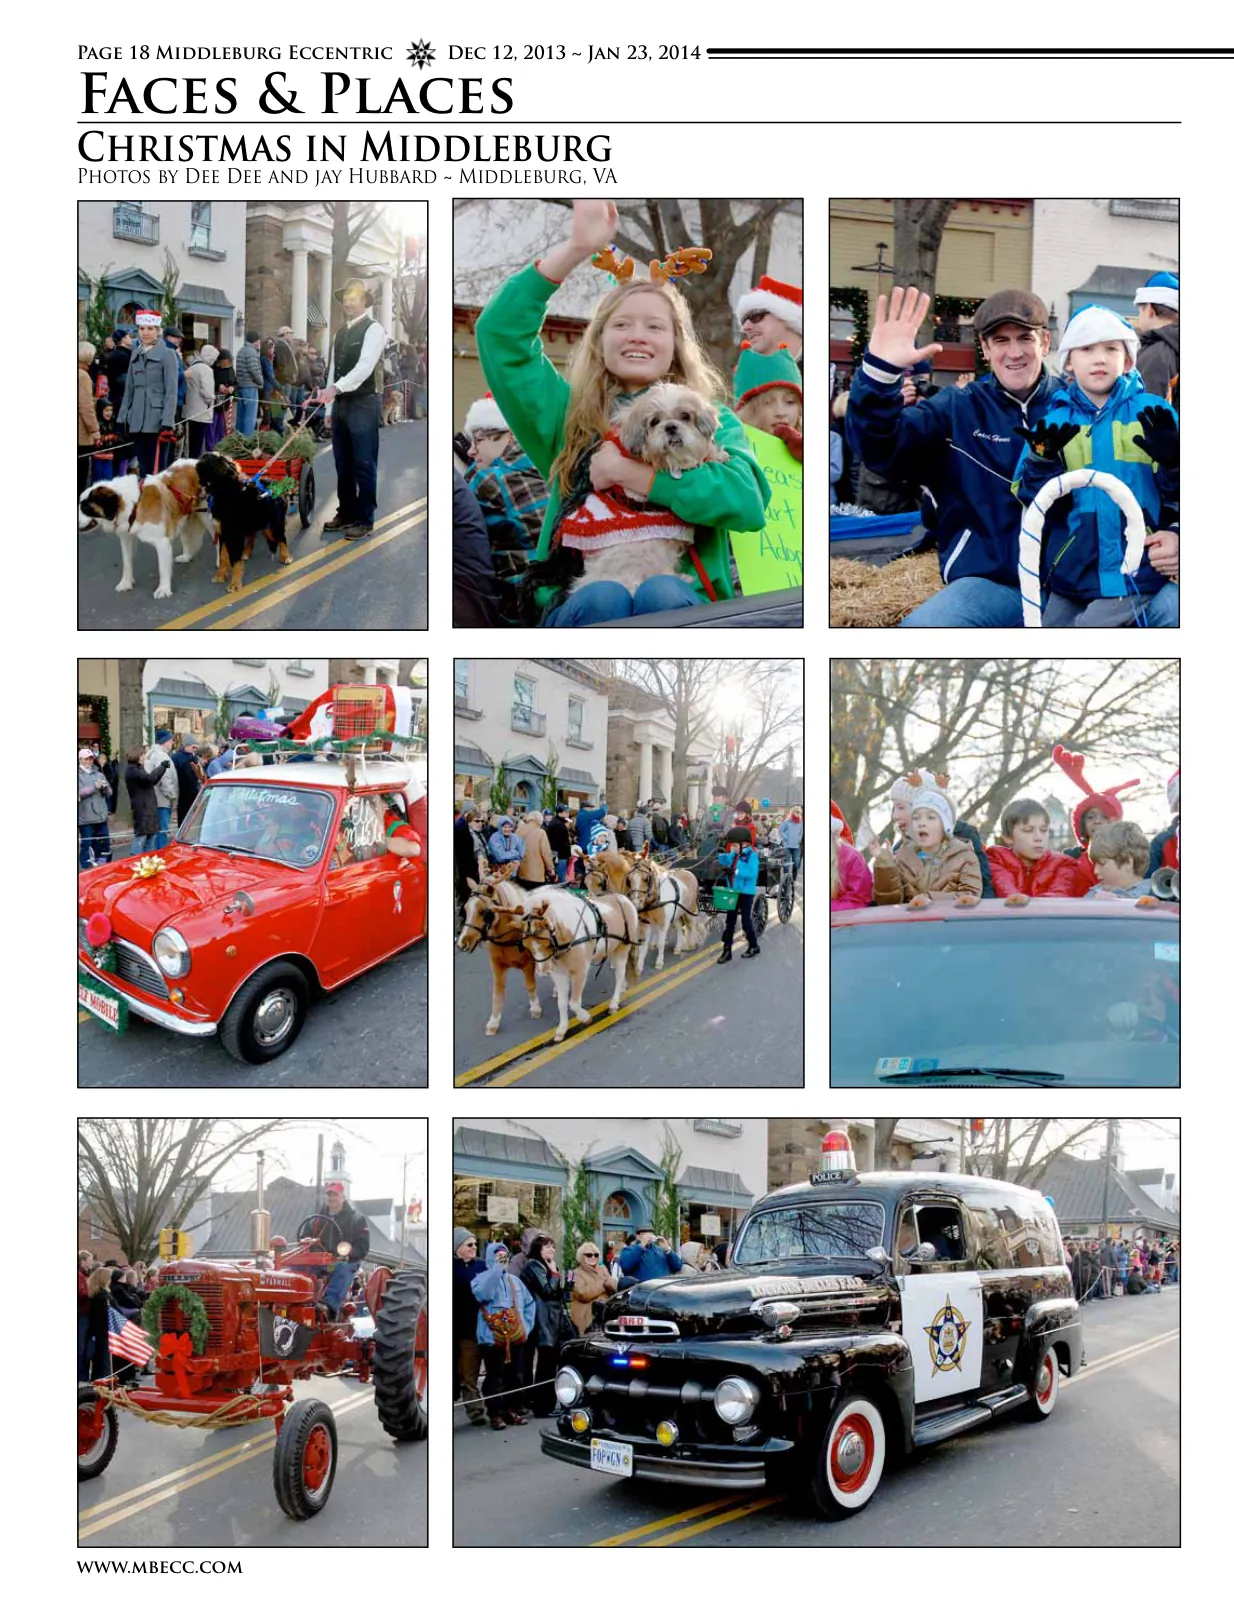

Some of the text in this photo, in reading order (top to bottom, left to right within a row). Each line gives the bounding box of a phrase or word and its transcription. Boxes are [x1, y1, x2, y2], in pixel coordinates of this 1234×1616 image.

[449, 45, 701, 63] DEC 12, 2013 JAN 23, 2014
[81, 72, 513, 114] FACES & PLACES
[78, 130, 612, 162] CHRISTMAS IN MIDDLEBURG
